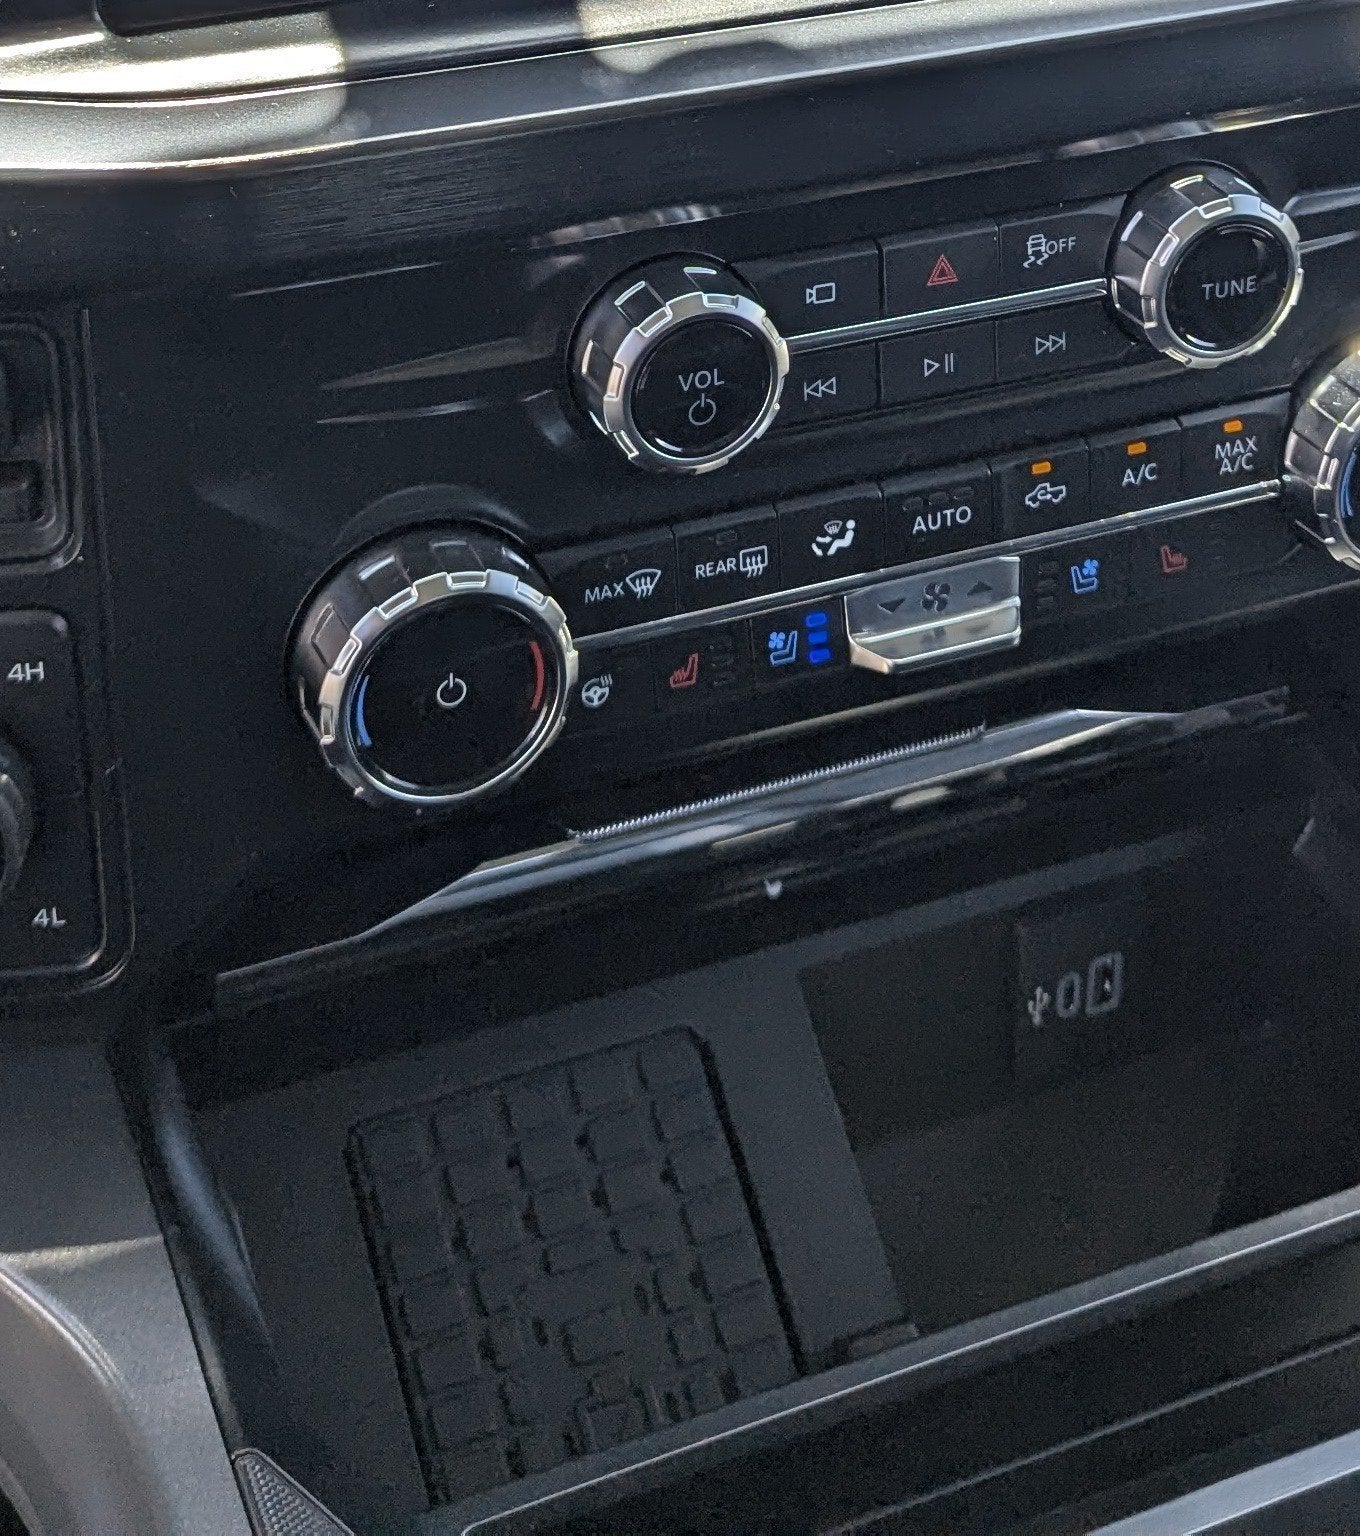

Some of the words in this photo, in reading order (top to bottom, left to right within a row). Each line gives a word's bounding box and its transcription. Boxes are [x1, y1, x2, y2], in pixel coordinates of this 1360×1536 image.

[1046, 236, 1076, 255] OFF
[1200, 274, 1258, 302] TUNE
[677, 365, 725, 393] VOL
[1214, 435, 1259, 460] MAX
[1122, 461, 1158, 488] A/C
[1218, 451, 1255, 476] A/C
[911, 505, 973, 535] AUTO
[694, 555, 739, 581] REAR
[584, 579, 625, 604] MAX
[7, 661, 45, 682] 4H
[32, 908, 66, 927] 4L
